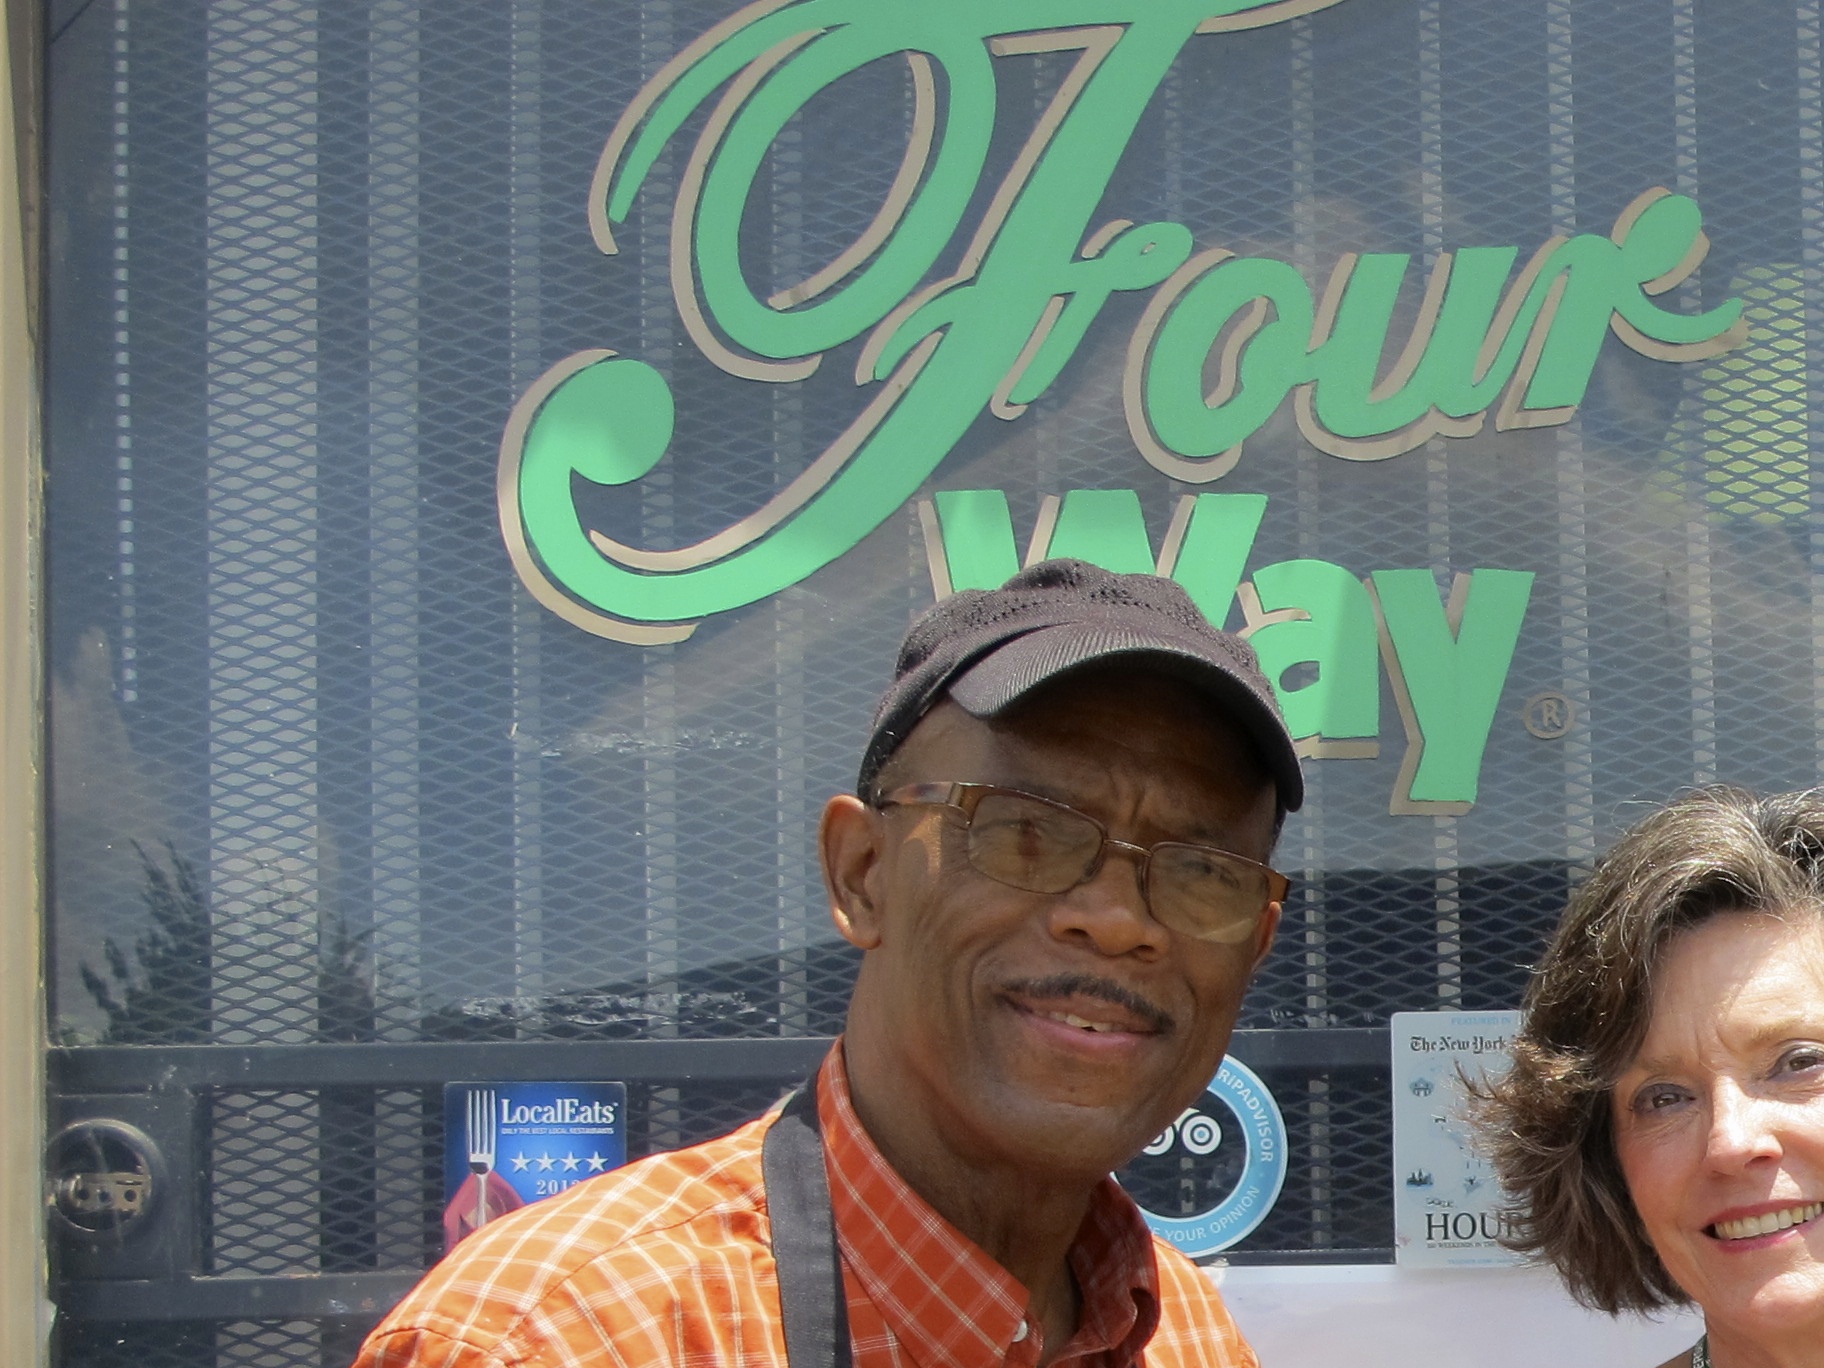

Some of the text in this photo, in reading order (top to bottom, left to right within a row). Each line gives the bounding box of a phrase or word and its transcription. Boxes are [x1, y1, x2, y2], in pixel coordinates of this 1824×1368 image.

[499, 0, 1748, 644] Four
[1410, 1035, 1508, 1054] The New York
[501, 1098, 615, 1124] LocalEats
[1165, 1185, 1260, 1242] YOUR OPINION
